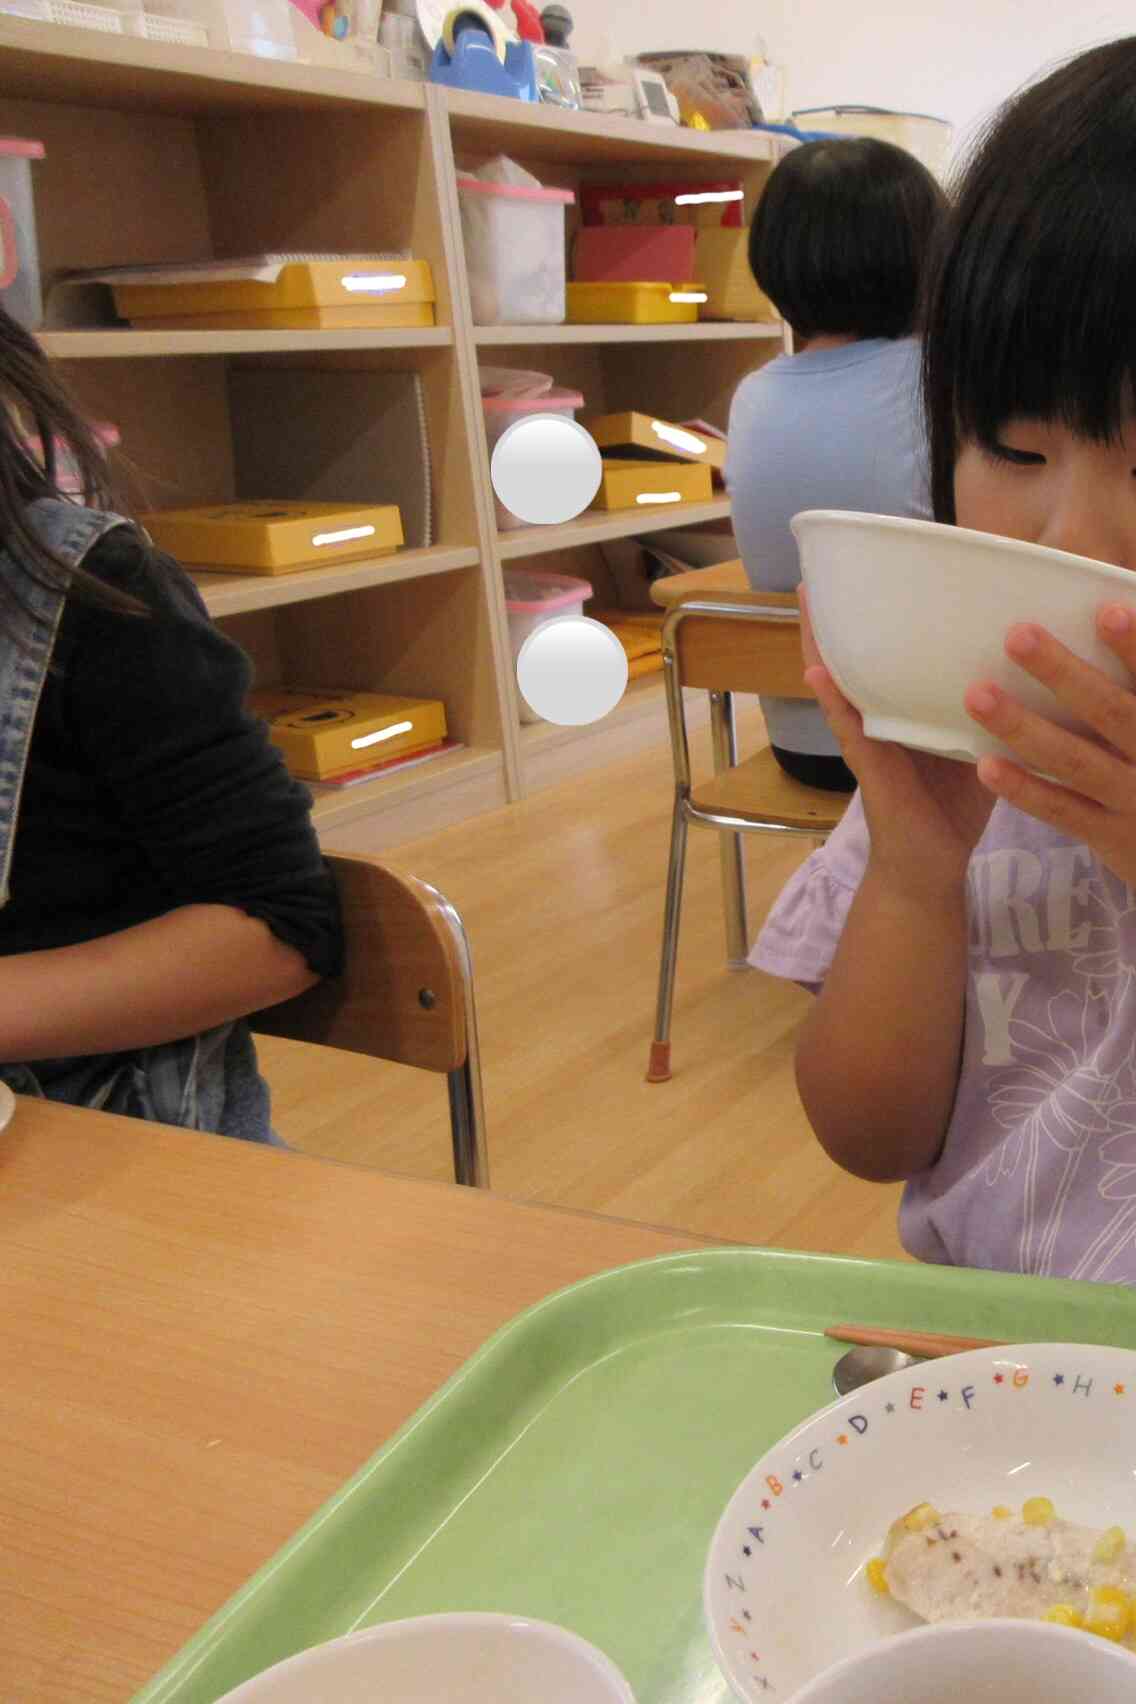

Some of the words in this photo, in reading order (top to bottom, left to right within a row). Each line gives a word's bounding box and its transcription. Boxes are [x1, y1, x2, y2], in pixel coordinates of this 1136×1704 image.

[746, 1527, 764, 1544] A
[766, 1475, 784, 1496] B
[809, 1449, 823, 1470] C
[848, 1415, 868, 1434] D
[910, 1387, 928, 1409] E
[961, 1386, 975, 1409] F
[1013, 1370, 1029, 1389] G
[1072, 1374, 1093, 1397] H
